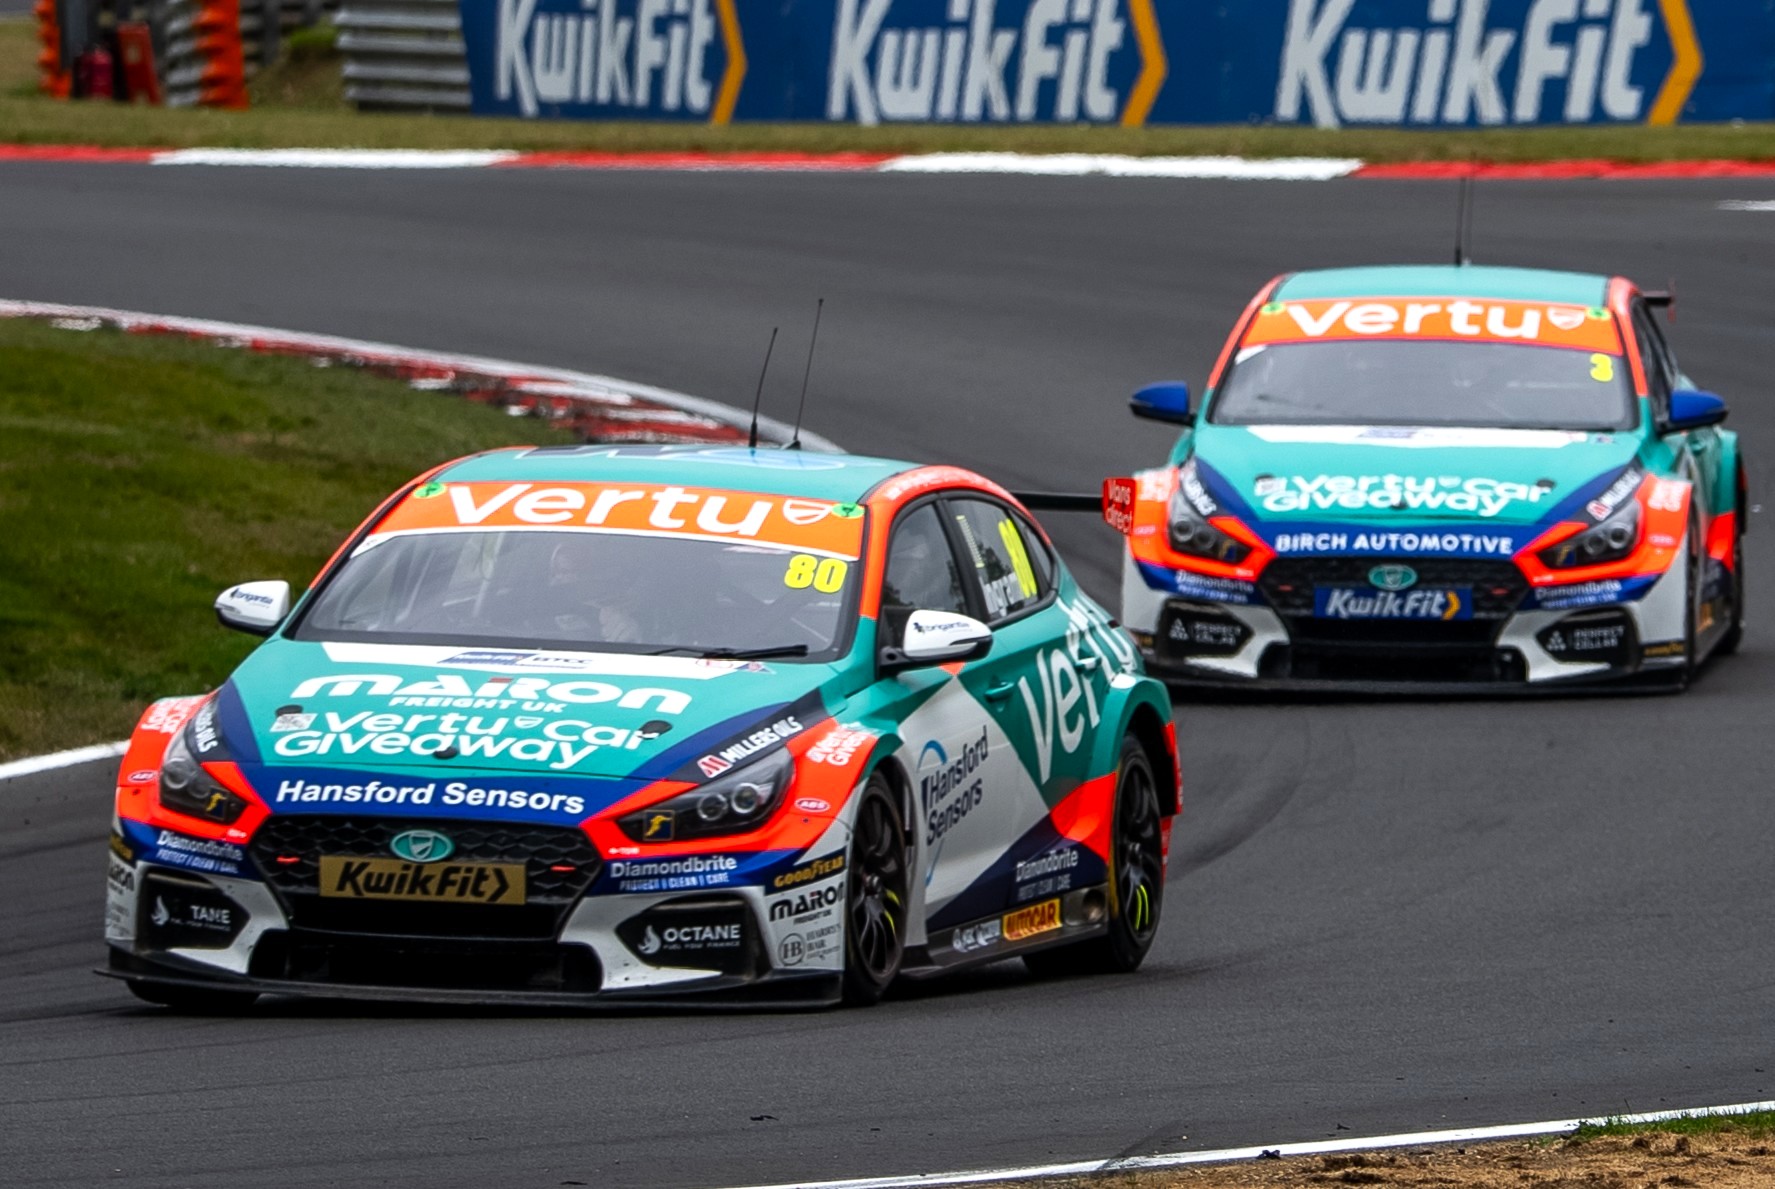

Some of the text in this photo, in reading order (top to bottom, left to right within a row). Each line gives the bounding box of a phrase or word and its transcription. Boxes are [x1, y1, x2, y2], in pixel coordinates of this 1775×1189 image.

[1589, 353, 1614, 382] 3
[1275, 533, 1514, 555] BIRCH AUTOMOTIVE
[784, 553, 848, 593] 80
[388, 697, 567, 713] FREIGHT UK
[274, 730, 599, 769] Giveaway
[719, 715, 803, 764] MILLERS OILS
[929, 725, 989, 809] Hansford
[276, 780, 585, 815] Hansford Sensors
[926, 777, 983, 846] Sensors
[610, 855, 738, 878] Diamondbrite
[663, 924, 742, 943] OCTANE
[1006, 902, 1057, 934] AUTOCAR
